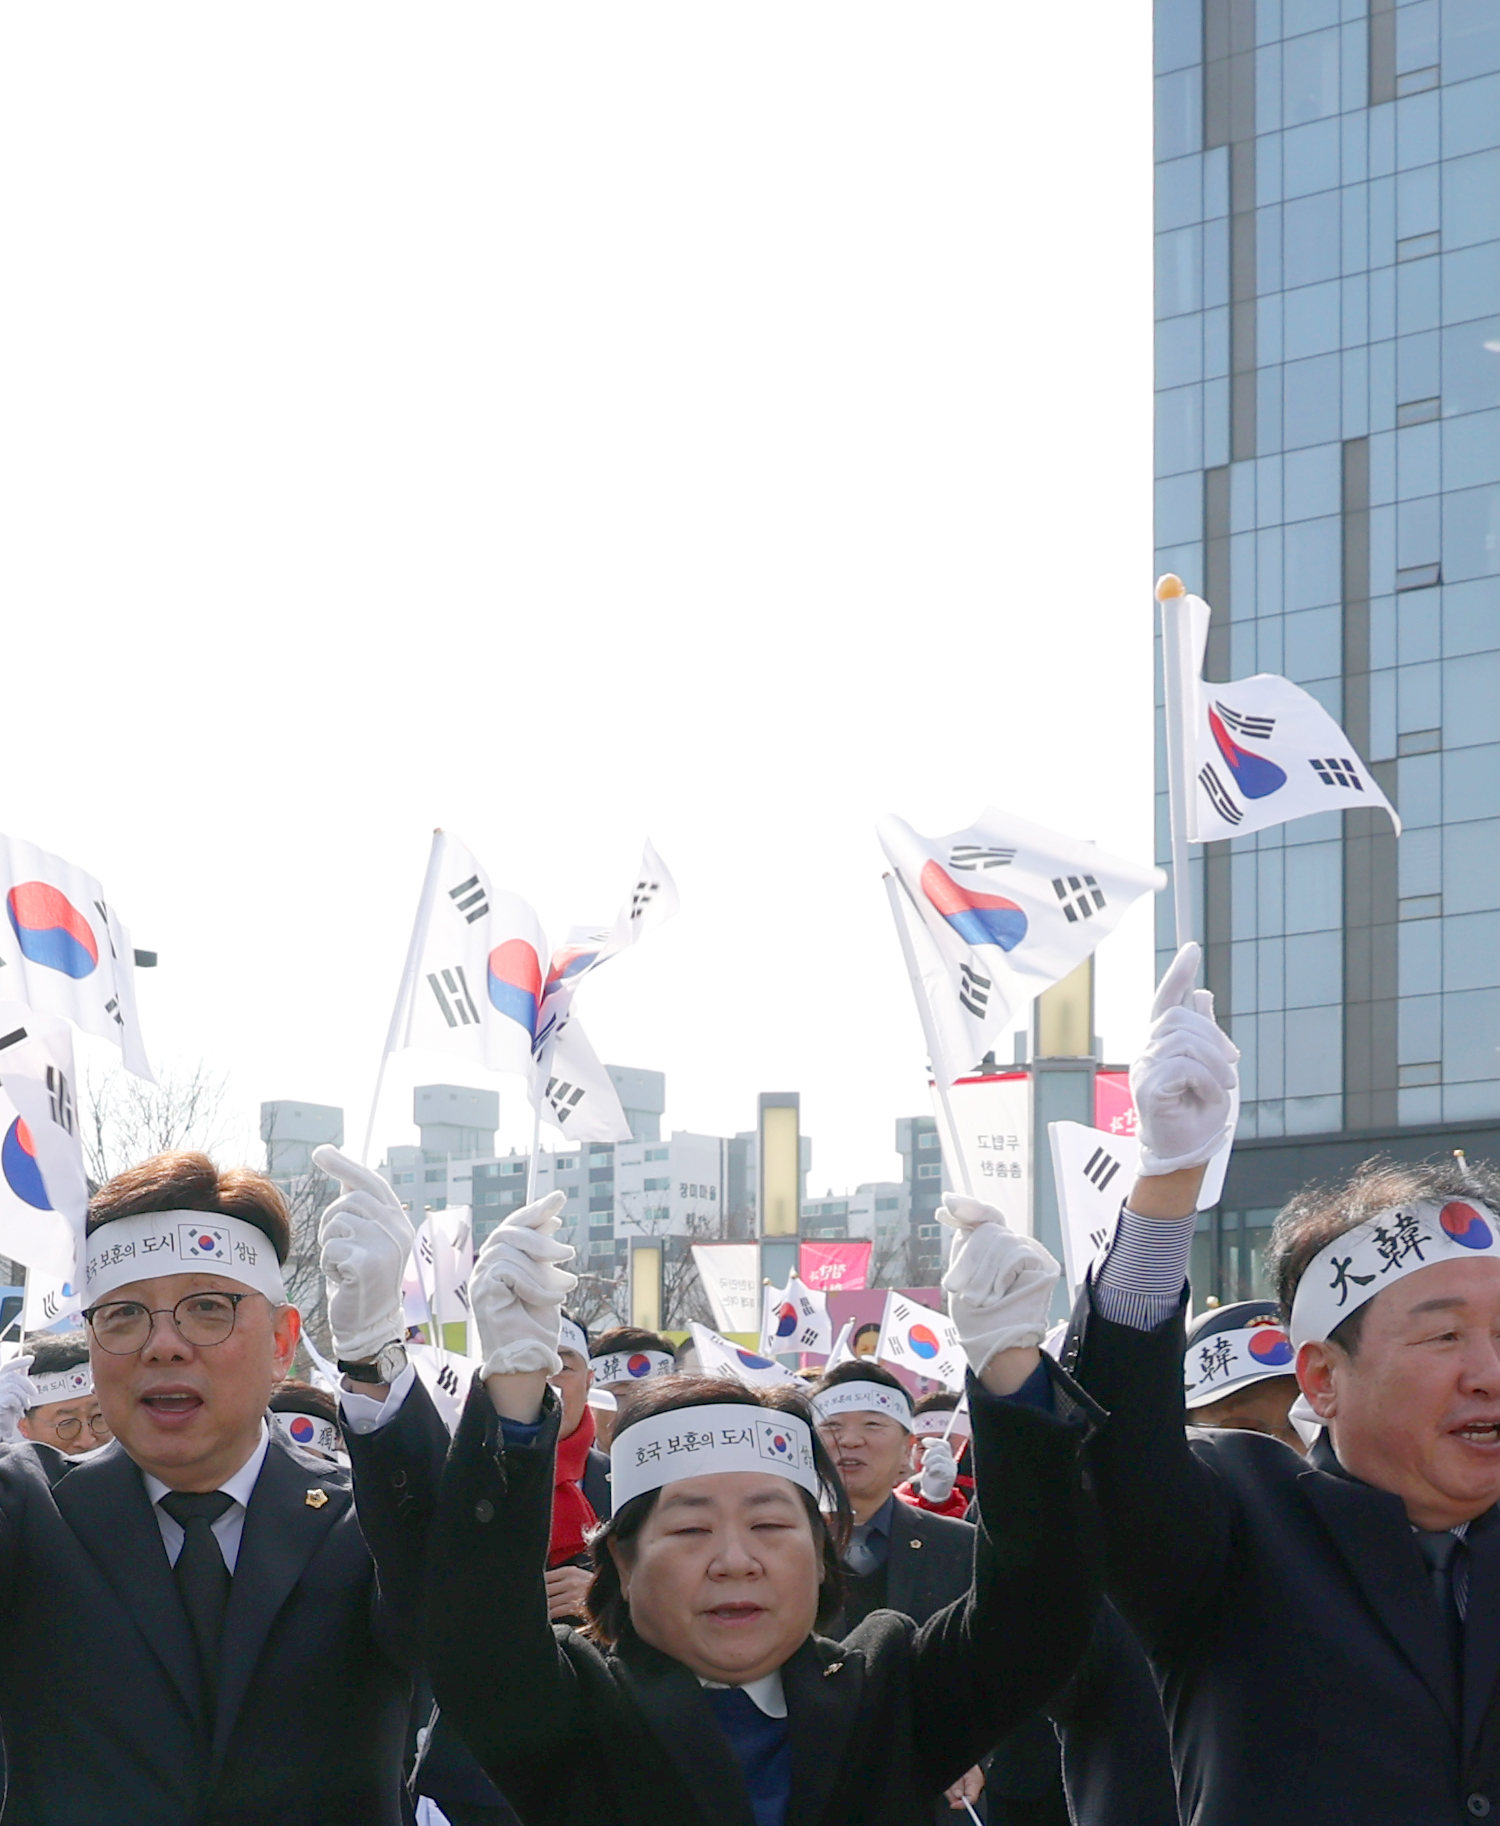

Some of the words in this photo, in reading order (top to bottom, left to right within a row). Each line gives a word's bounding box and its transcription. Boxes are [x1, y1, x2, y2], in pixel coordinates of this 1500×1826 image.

[99, 1242, 137, 1270] 보훈의
[141, 1232, 175, 1255] 도시
[233, 1241, 258, 1266] 성남
[1329, 1212, 1433, 1307] 大韓
[854, 1392, 871, 1401] 도시
[635, 1440, 663, 1467] 호국
[667, 1431, 715, 1455] 보훈의
[720, 1427, 755, 1449] 도시
